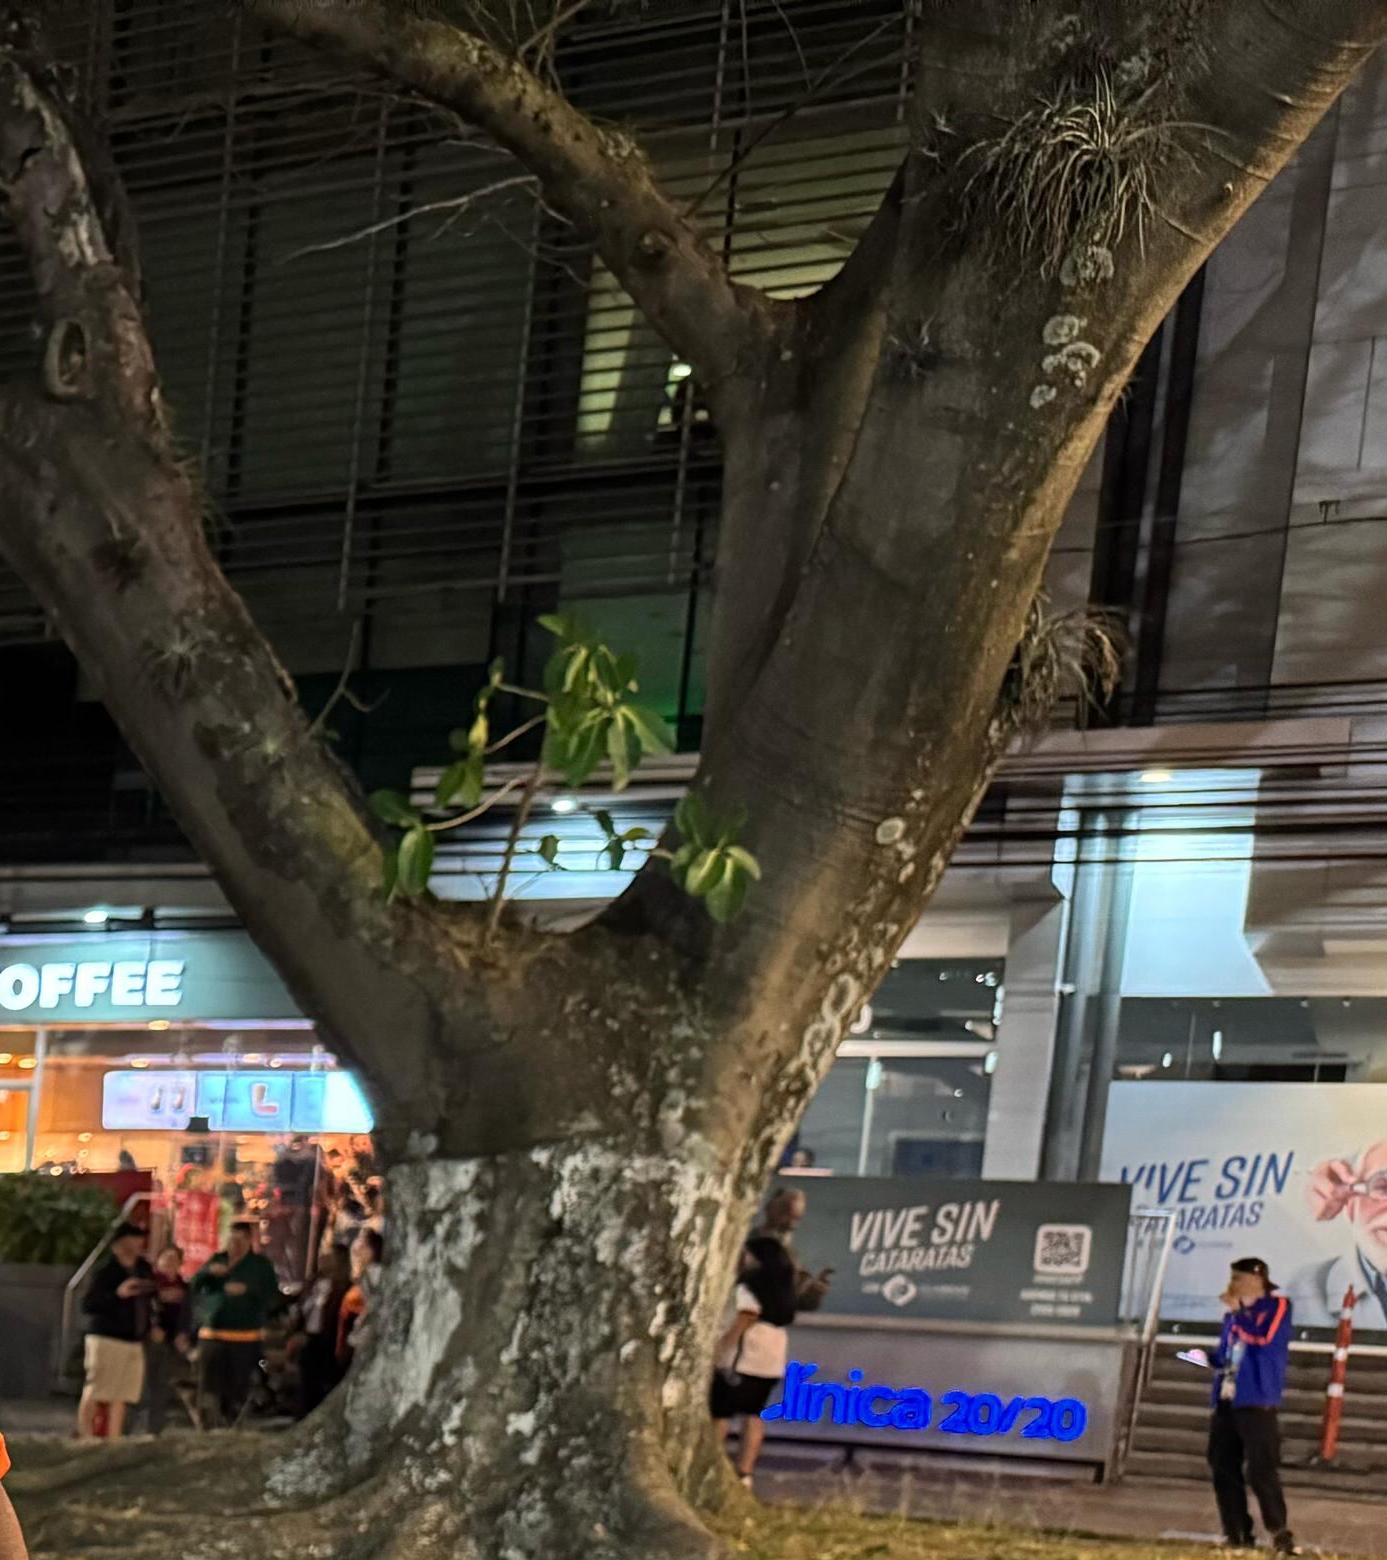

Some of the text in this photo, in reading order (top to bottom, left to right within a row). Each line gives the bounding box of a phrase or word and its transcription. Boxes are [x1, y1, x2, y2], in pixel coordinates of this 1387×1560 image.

[1215, 1150, 1294, 1200] SIN
[850, 1199, 1001, 1252] VIVE SIN
[859, 1243, 975, 1275] CATARATAS
[939, 1390, 1088, 1442] 20/20
